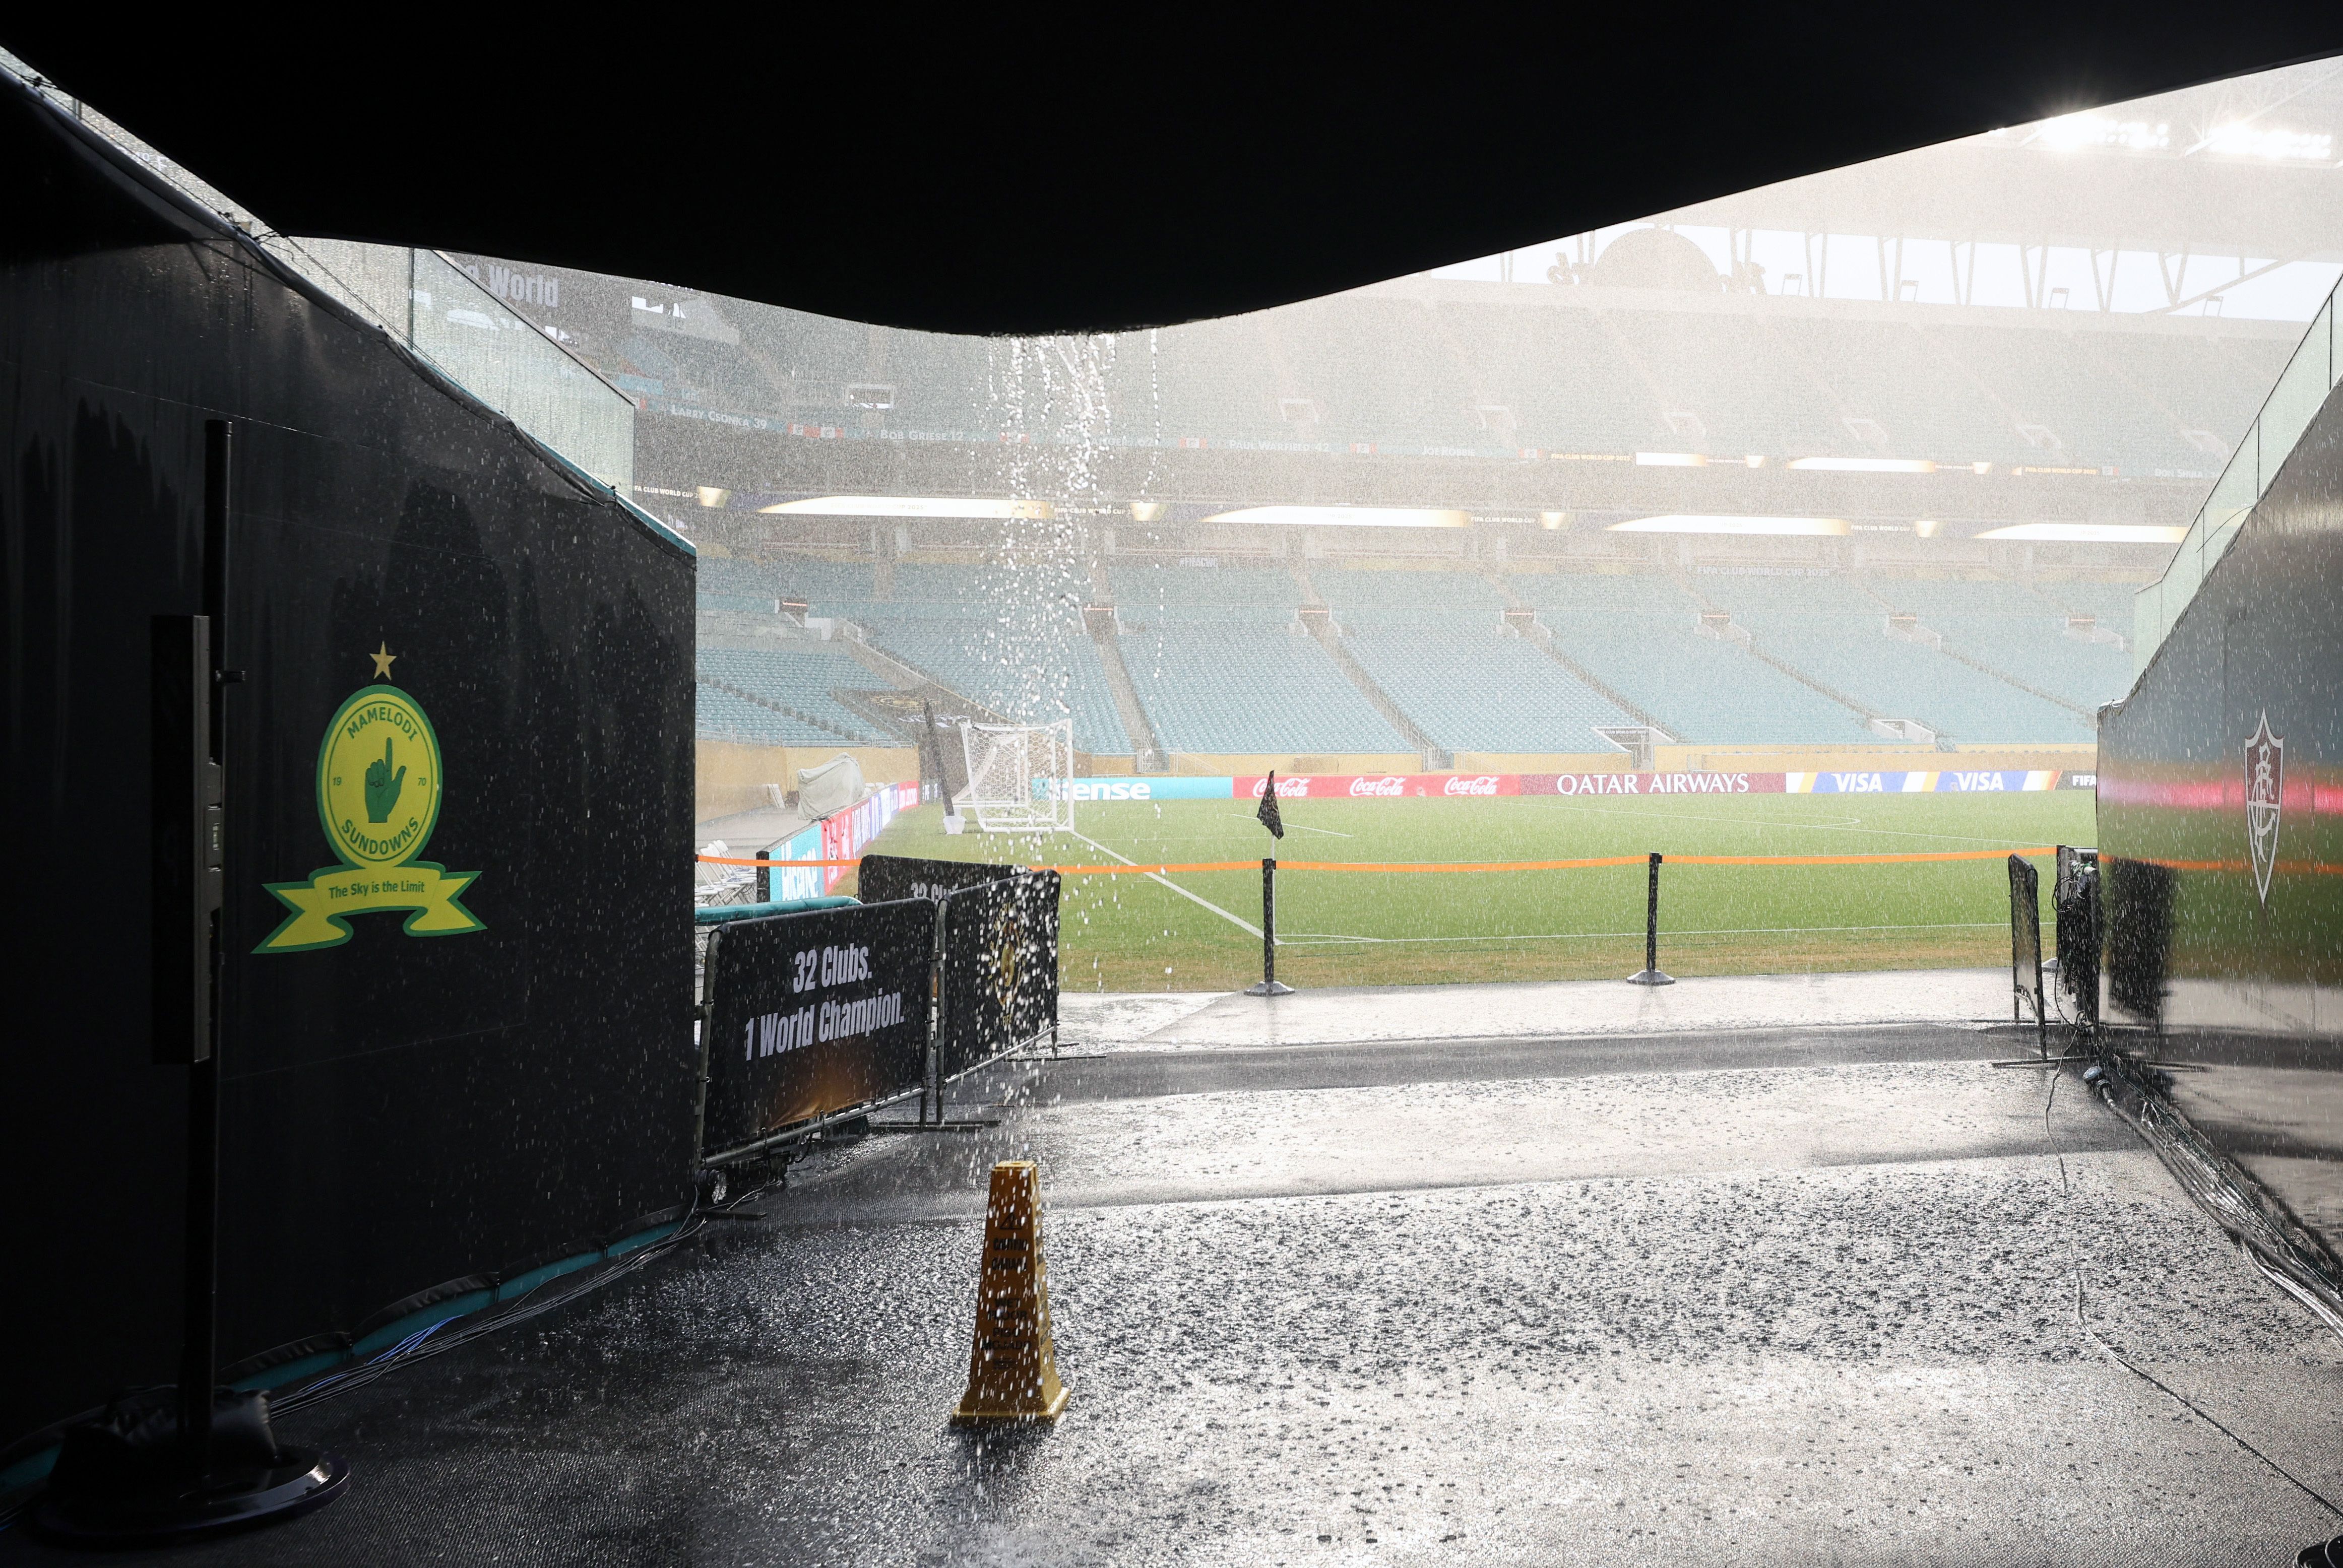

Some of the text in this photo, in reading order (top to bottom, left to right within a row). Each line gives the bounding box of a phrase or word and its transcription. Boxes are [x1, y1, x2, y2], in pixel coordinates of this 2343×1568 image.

[488, 264, 559, 307] World
[671, 405, 767, 429] LARRY CSONKA 39
[881, 430, 963, 441] BOB GRIESE 12
[660, 488, 680, 496] WORLD
[348, 706, 418, 741] MAMELODI
[332, 777, 426, 786] 19 70
[1350, 777, 1406, 796] Coca-Cola
[1444, 776, 1499, 796] Coca-Cola
[1557, 773, 1749, 795] QATAR AIRWAYS
[1831, 773, 1883, 792] VISA
[1953, 772, 2004, 791] VISA
[2072, 775, 2097, 786] FIFA
[340, 817, 419, 855] SUNDOWNS
[329, 880, 424, 899] The Sky is the Limit
[793, 943, 872, 993] 32 Clubs.
[745, 988, 905, 1061] 1 World Champion.
